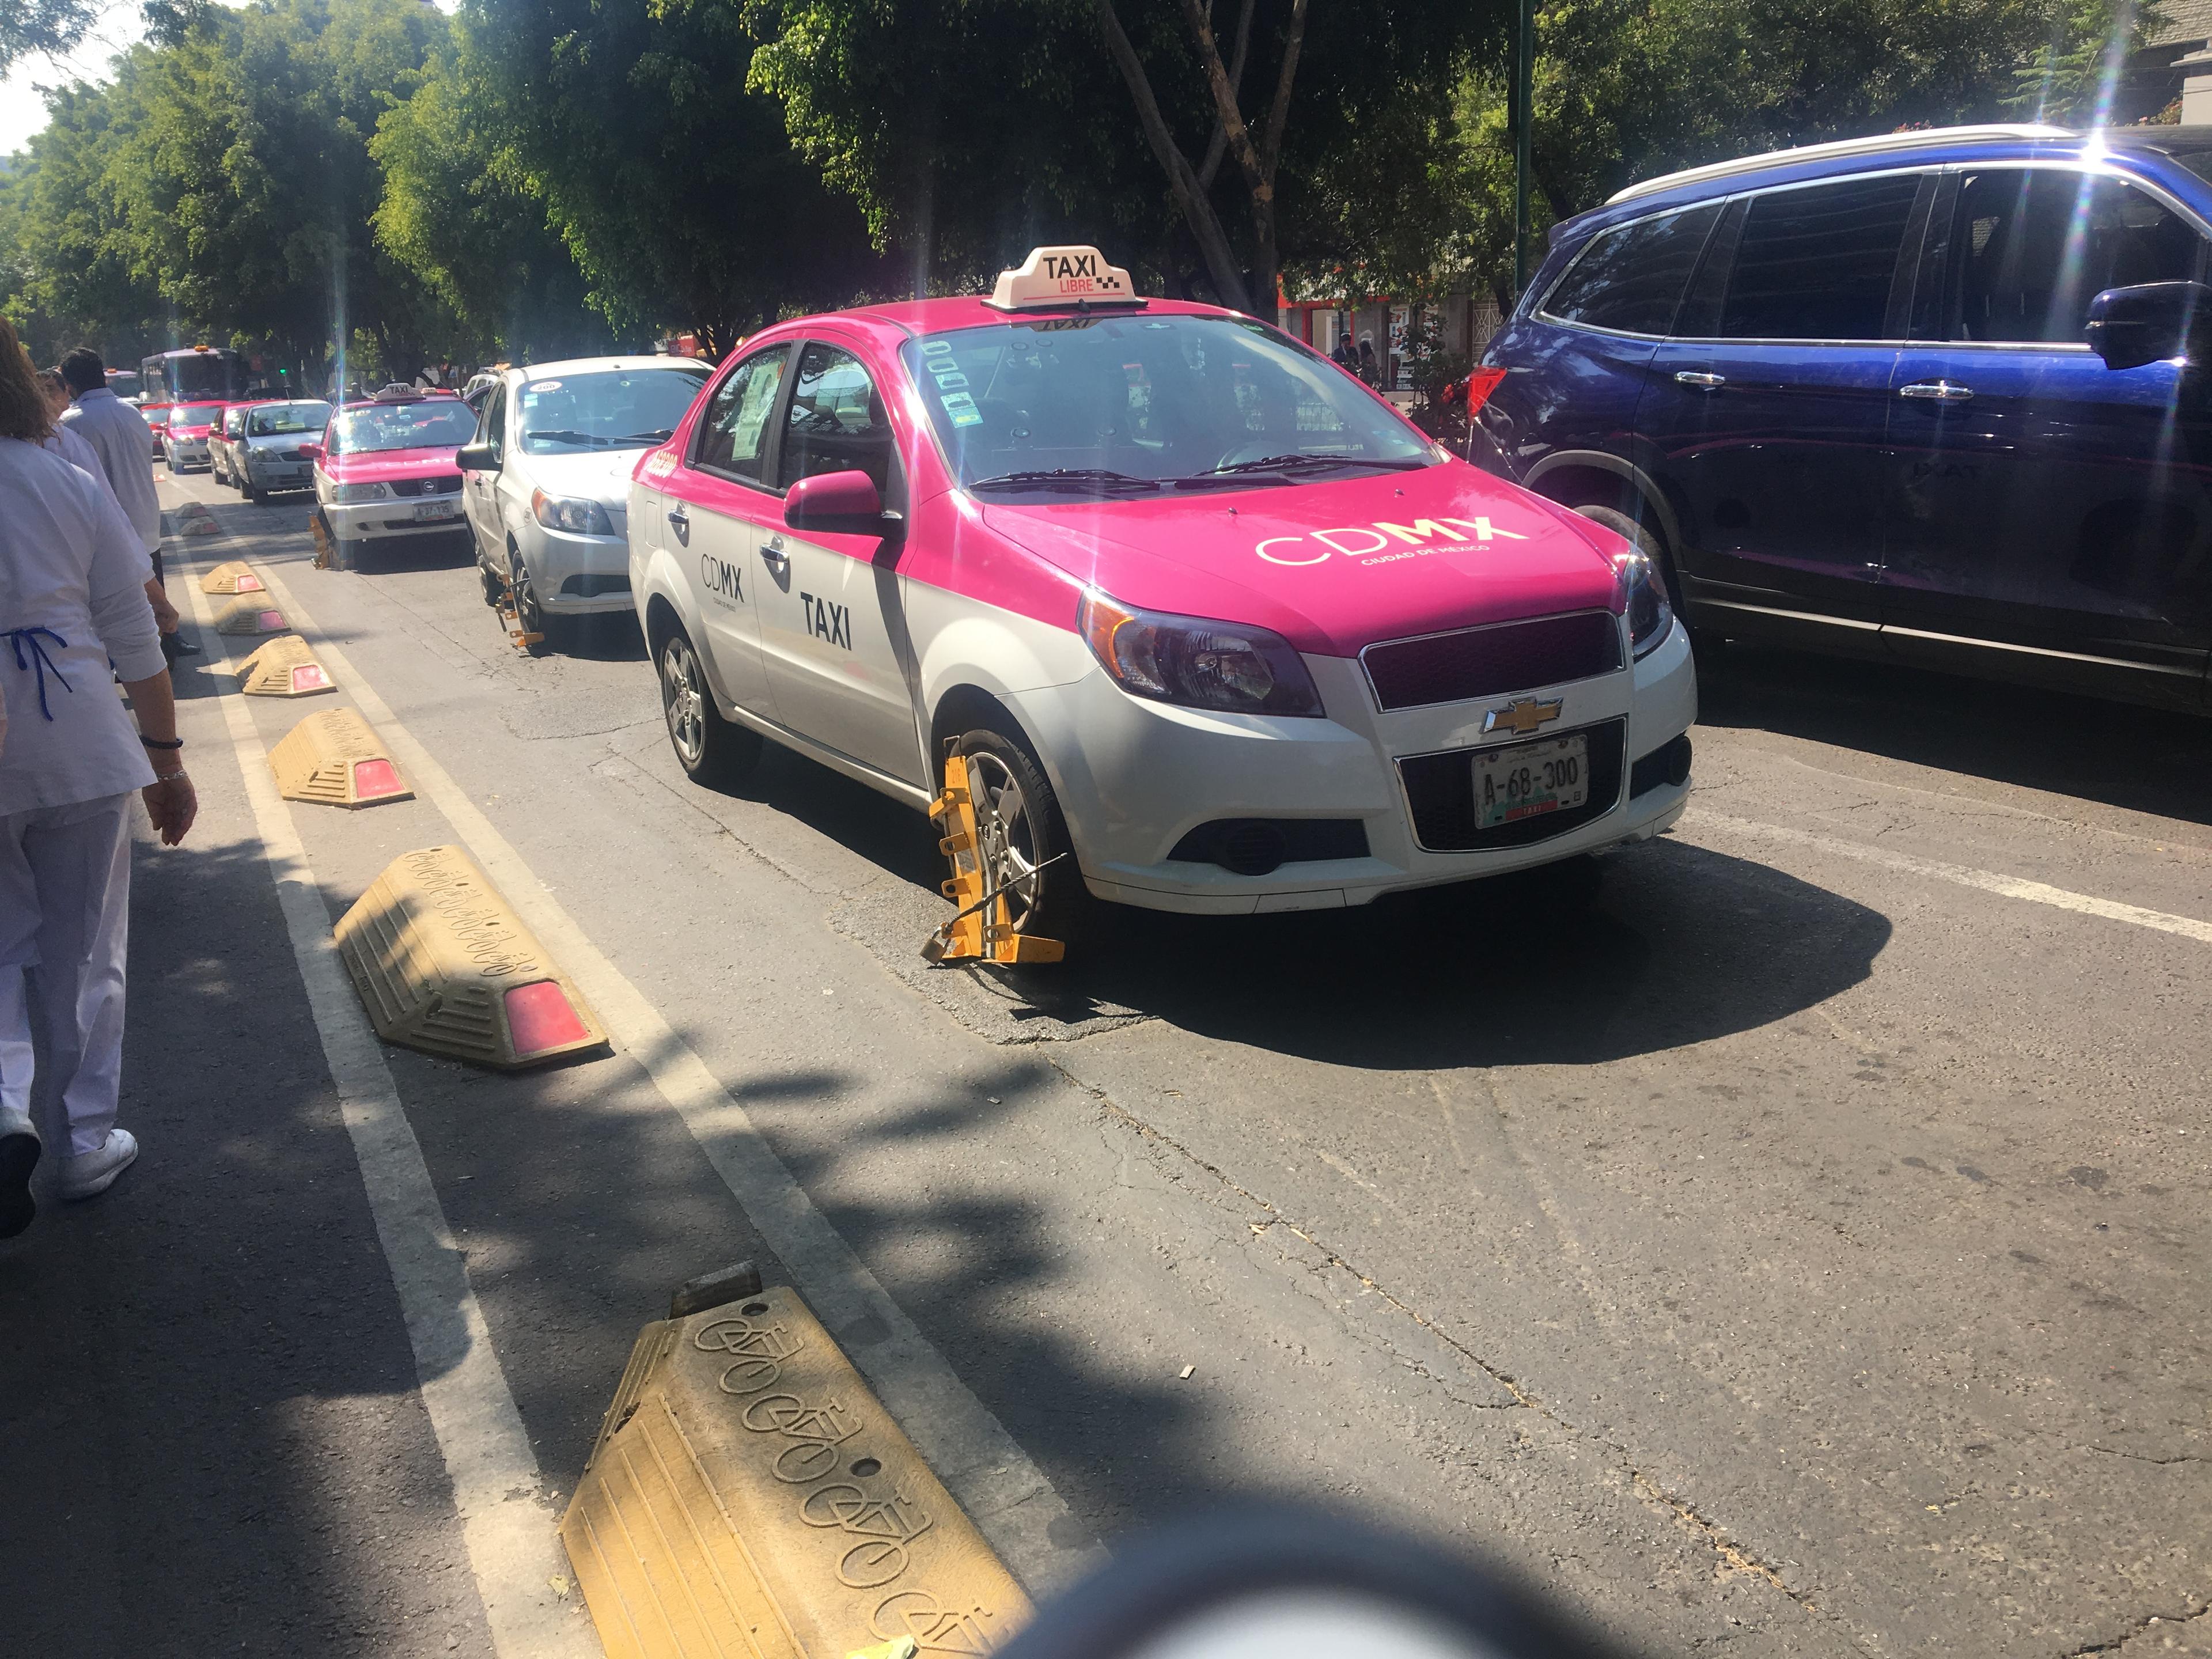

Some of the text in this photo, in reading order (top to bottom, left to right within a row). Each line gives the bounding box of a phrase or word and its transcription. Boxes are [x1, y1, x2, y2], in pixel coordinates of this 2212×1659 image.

[1043, 255, 1096, 279] TAXI
[1060, 278, 1094, 293] LIBRE
[389, 386, 408, 394] TAXI
[1256, 516, 1531, 566] CDMX
[1361, 552, 1415, 566] CIUDAD
[701, 553, 745, 603] CDMX
[800, 591, 852, 652] TAXI
[952, 768, 961, 784] 216
[1484, 756, 1578, 806] A-68-300
[1522, 805, 1541, 815] TAXI
